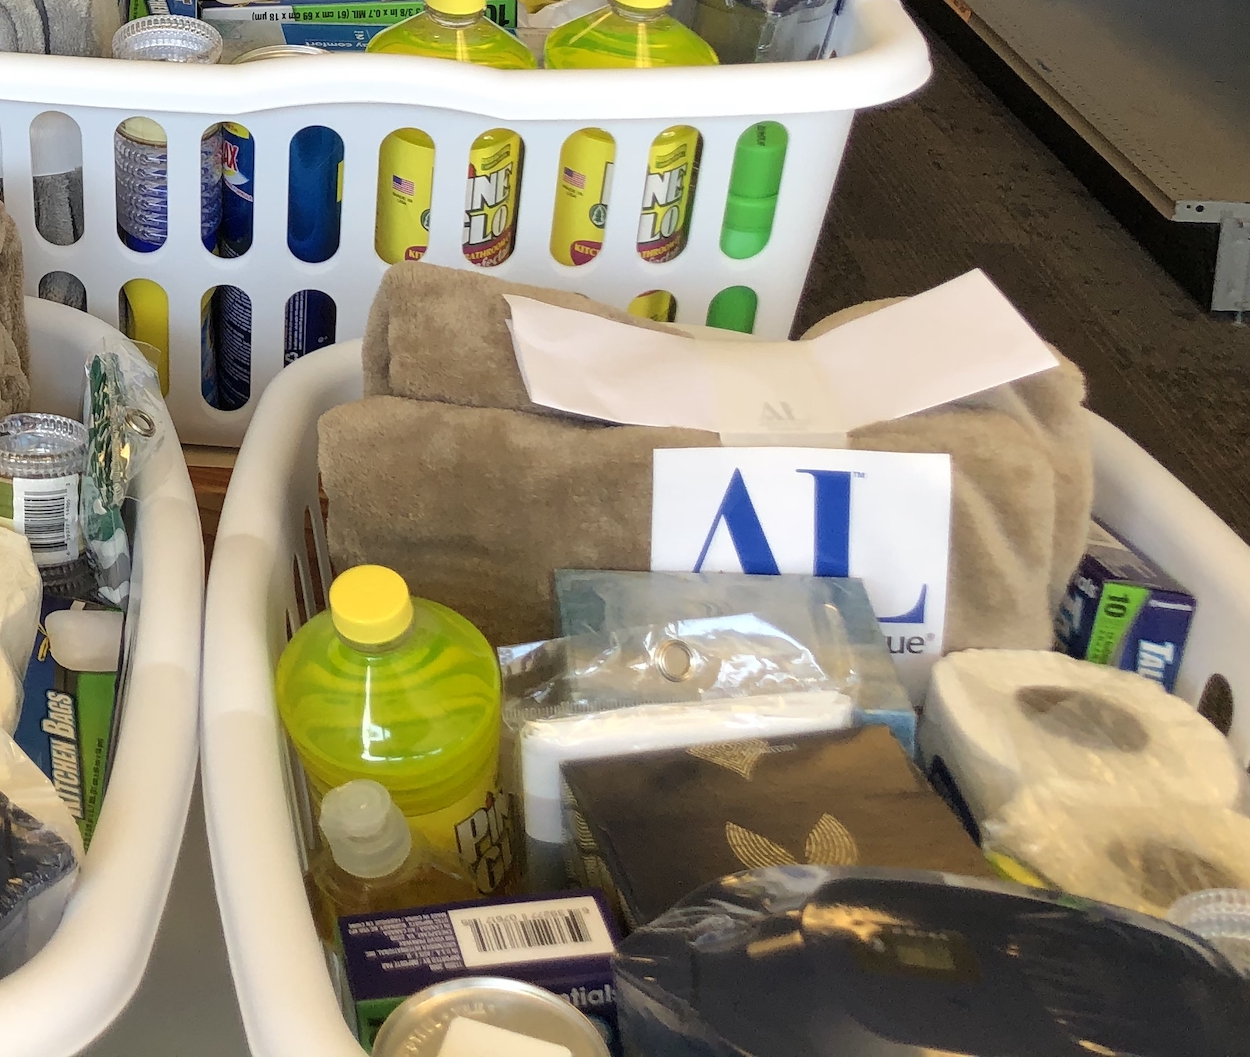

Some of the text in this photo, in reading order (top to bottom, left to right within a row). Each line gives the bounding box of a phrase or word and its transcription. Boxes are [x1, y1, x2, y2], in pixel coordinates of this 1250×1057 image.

[268, 12, 280, 21] 18
[288, 12, 300, 21] cm
[302, 12, 313, 20] 69
[336, 10, 350, 20] (61
[352, 10, 366, 19] MIL
[368, 10, 381, 18] 0.7
[389, 9, 398, 17] in
[487, 2, 511, 26] 10
[222, 141, 239, 172] AX
[641, 162, 688, 209] NE
[462, 204, 508, 246] LO
[637, 204, 680, 245] LO
[573, 243, 600, 256] KITC
[1104, 594, 1130, 618] 10
[41, 690, 84, 819] KITCHEN BAGS
